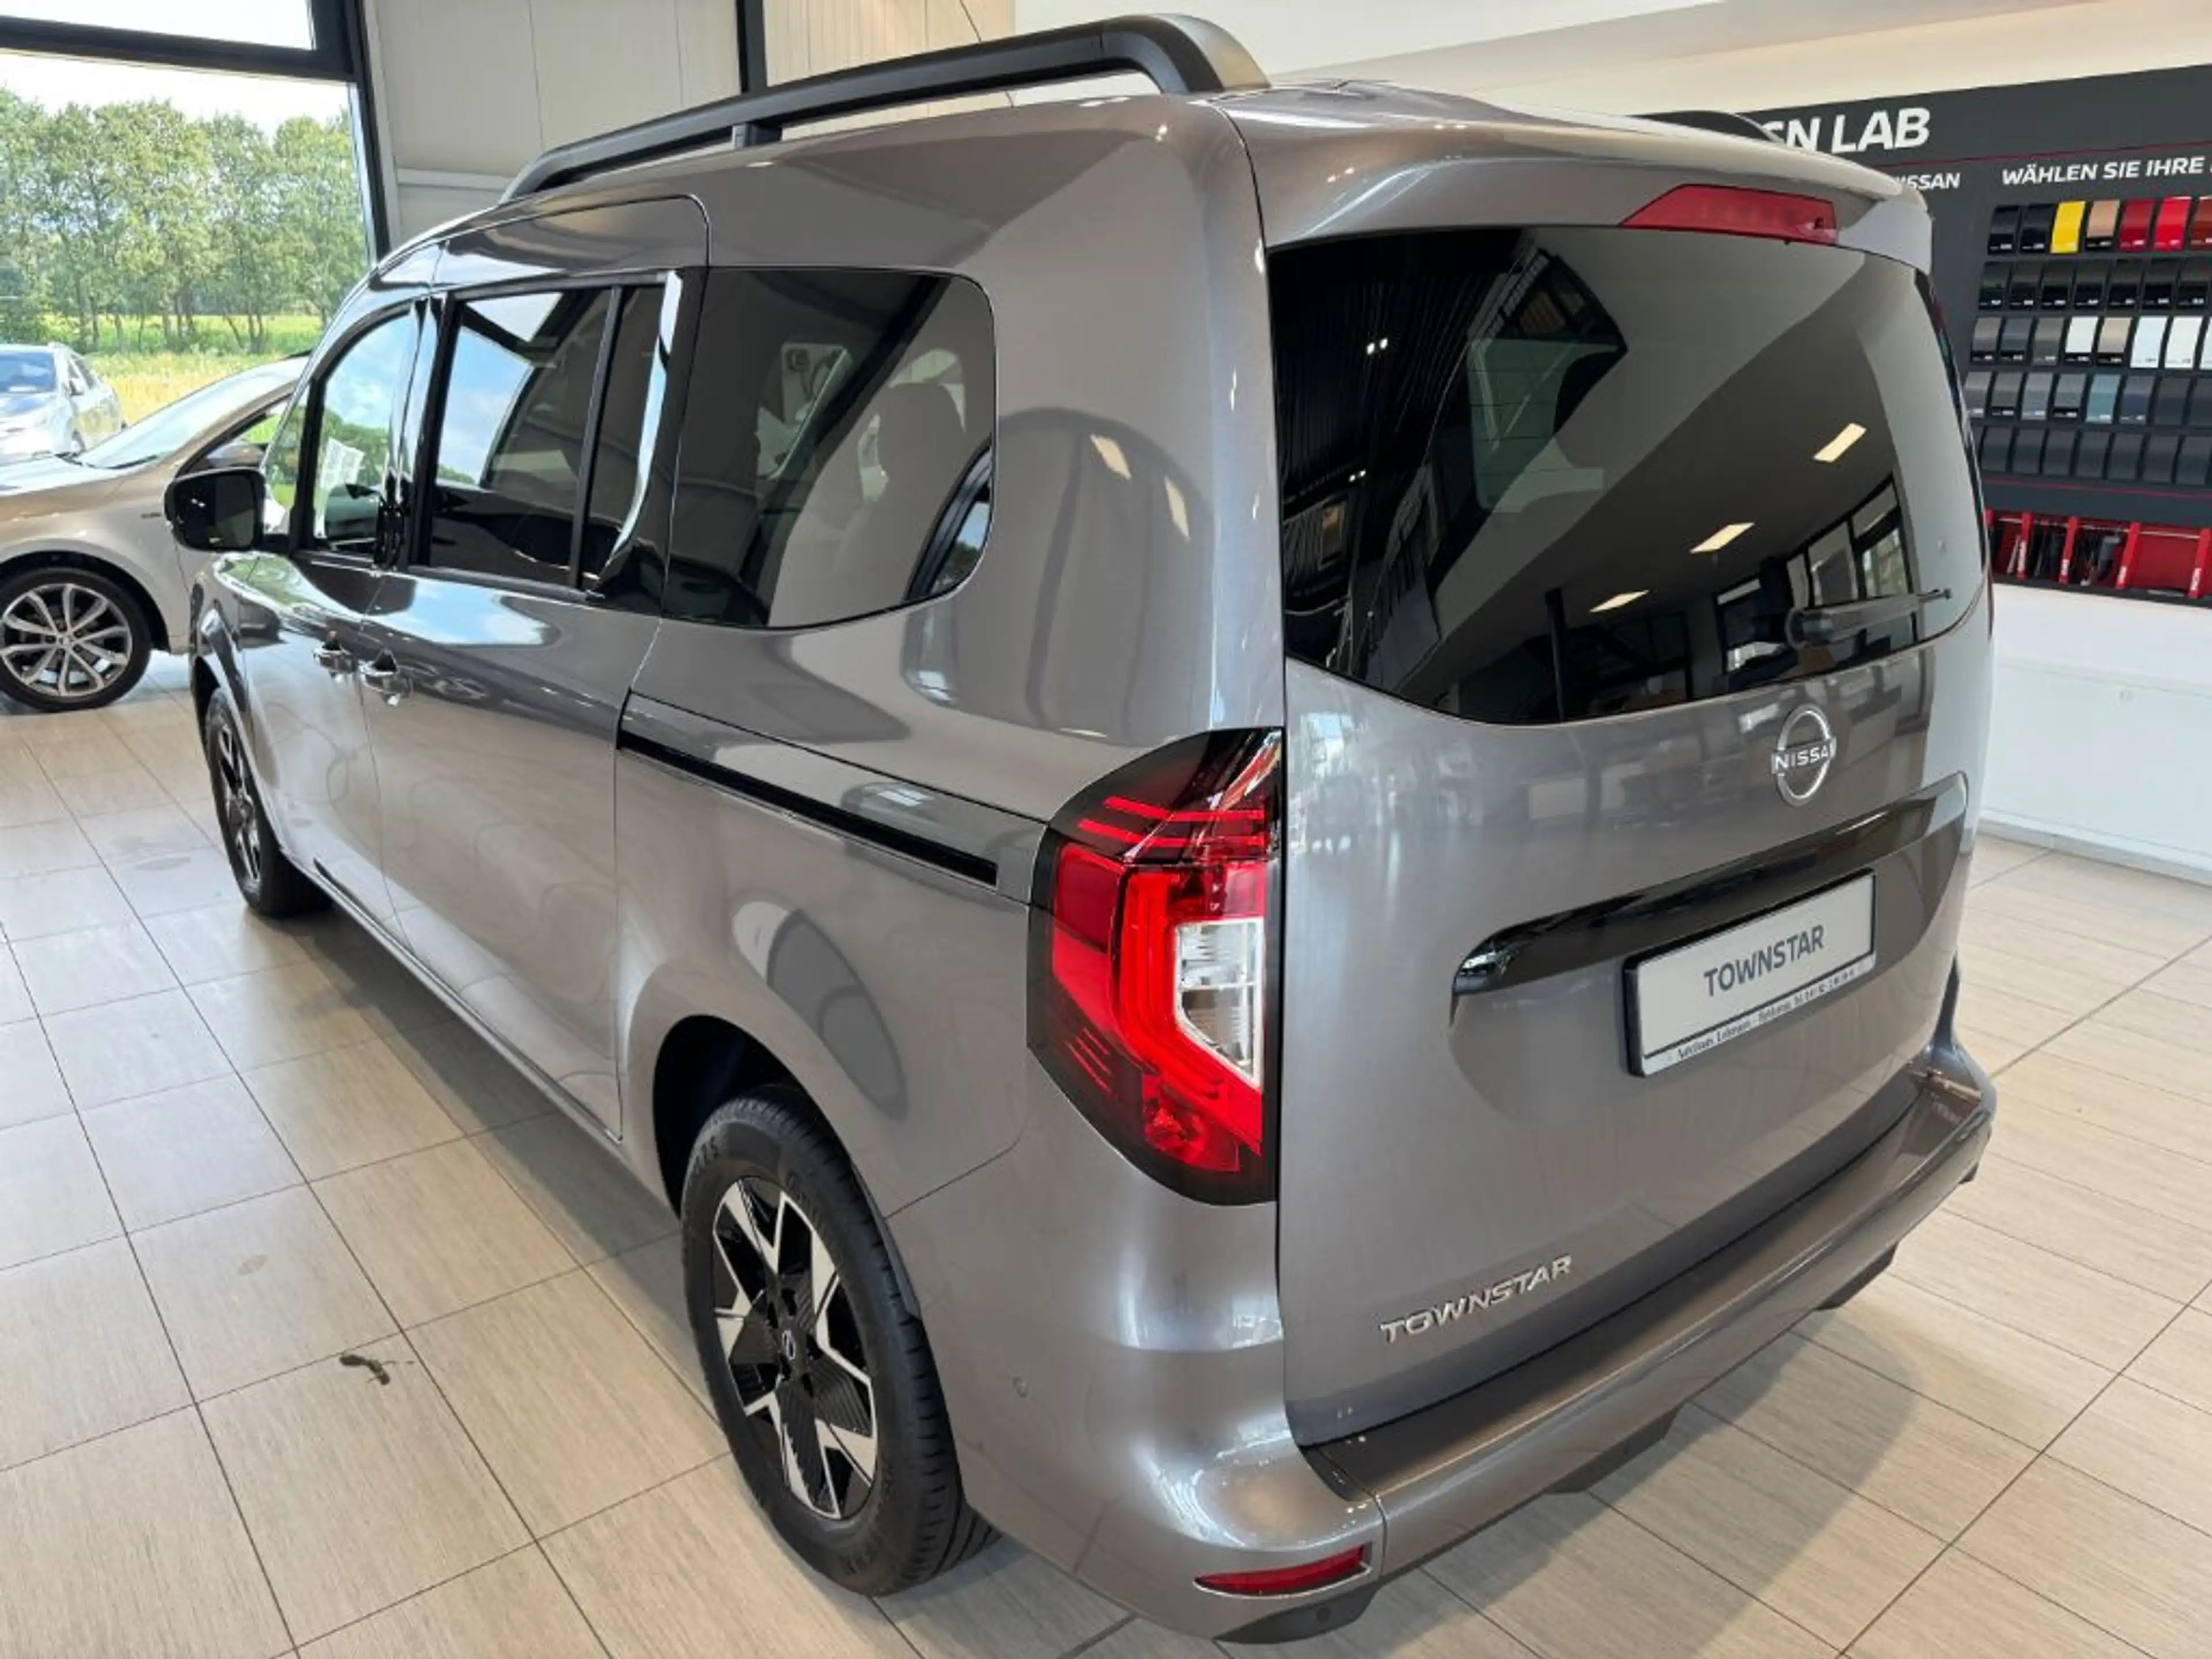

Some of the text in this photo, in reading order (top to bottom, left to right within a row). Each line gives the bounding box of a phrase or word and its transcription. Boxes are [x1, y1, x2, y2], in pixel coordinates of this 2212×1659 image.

[1831, 107, 1930, 153] LAB
[2002, 155, 2206, 185] WÄHLEN SIE IHRE
[1703, 924, 1824, 997] TOWNSTAR
[1380, 1253, 1572, 1343] TOWNSTAR
